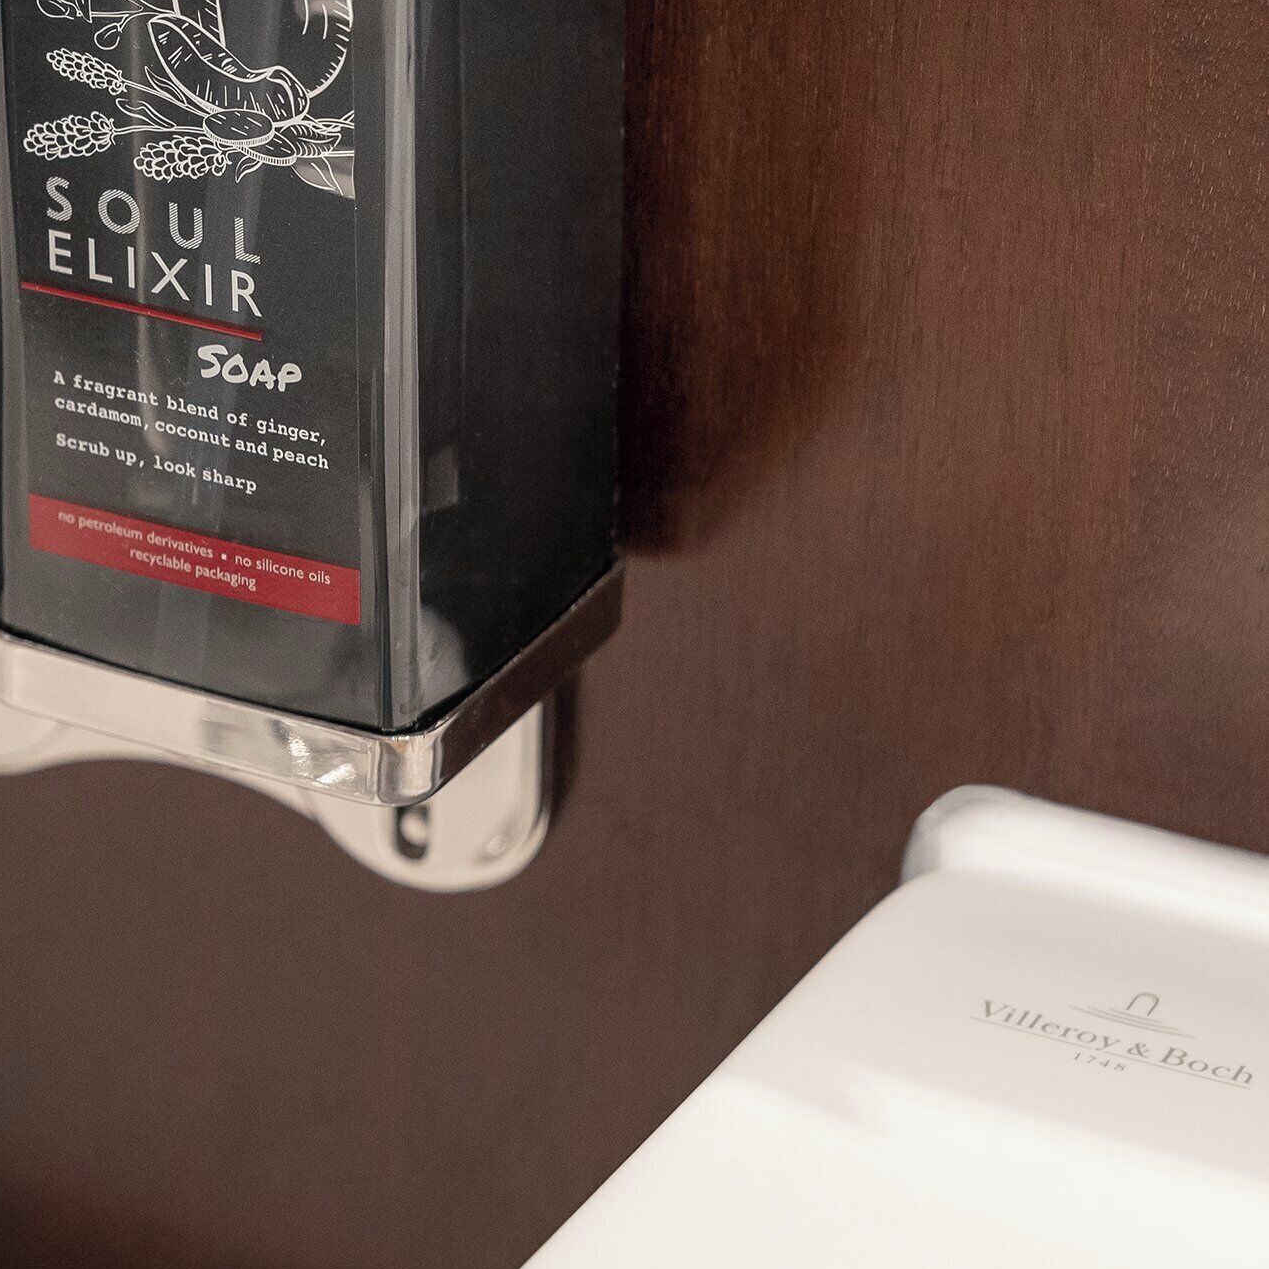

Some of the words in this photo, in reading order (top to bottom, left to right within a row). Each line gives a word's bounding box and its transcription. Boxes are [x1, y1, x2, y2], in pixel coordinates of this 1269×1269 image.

[46, 176, 262, 265] SOUL
[48, 229, 263, 318] ELIXIR
[197, 344, 303, 392] SOAP
[53, 370, 66, 385] A
[72, 374, 159, 407] fragrant
[166, 395, 219, 421] blend
[226, 411, 249, 427] of
[256, 419, 327, 445] ginger,
[54, 395, 150, 432] cardamom,
[155, 420, 231, 448] coconut
[235, 437, 268, 457] and
[273, 447, 329, 470] peach
[55, 432, 110, 458] Scrub
[115, 448, 146, 469] up,
[153, 455, 196, 478] look
[202, 468, 257, 494] sharp
[58, 510, 75, 525] no
[78, 516, 143, 542] petroleum
[146, 531, 214, 559] derivatives
[234, 554, 252, 568] no
[256, 558, 305, 580] silicone
[308, 570, 331, 585] oils
[129, 548, 191, 574] recyclable
[195, 566, 257, 592] packaging
[982, 999, 1122, 1051] Villeroy
[1126, 1041, 1151, 1059] &
[1160, 1047, 1255, 1085] Boch
[1072, 1052, 1127, 1073] 1748
